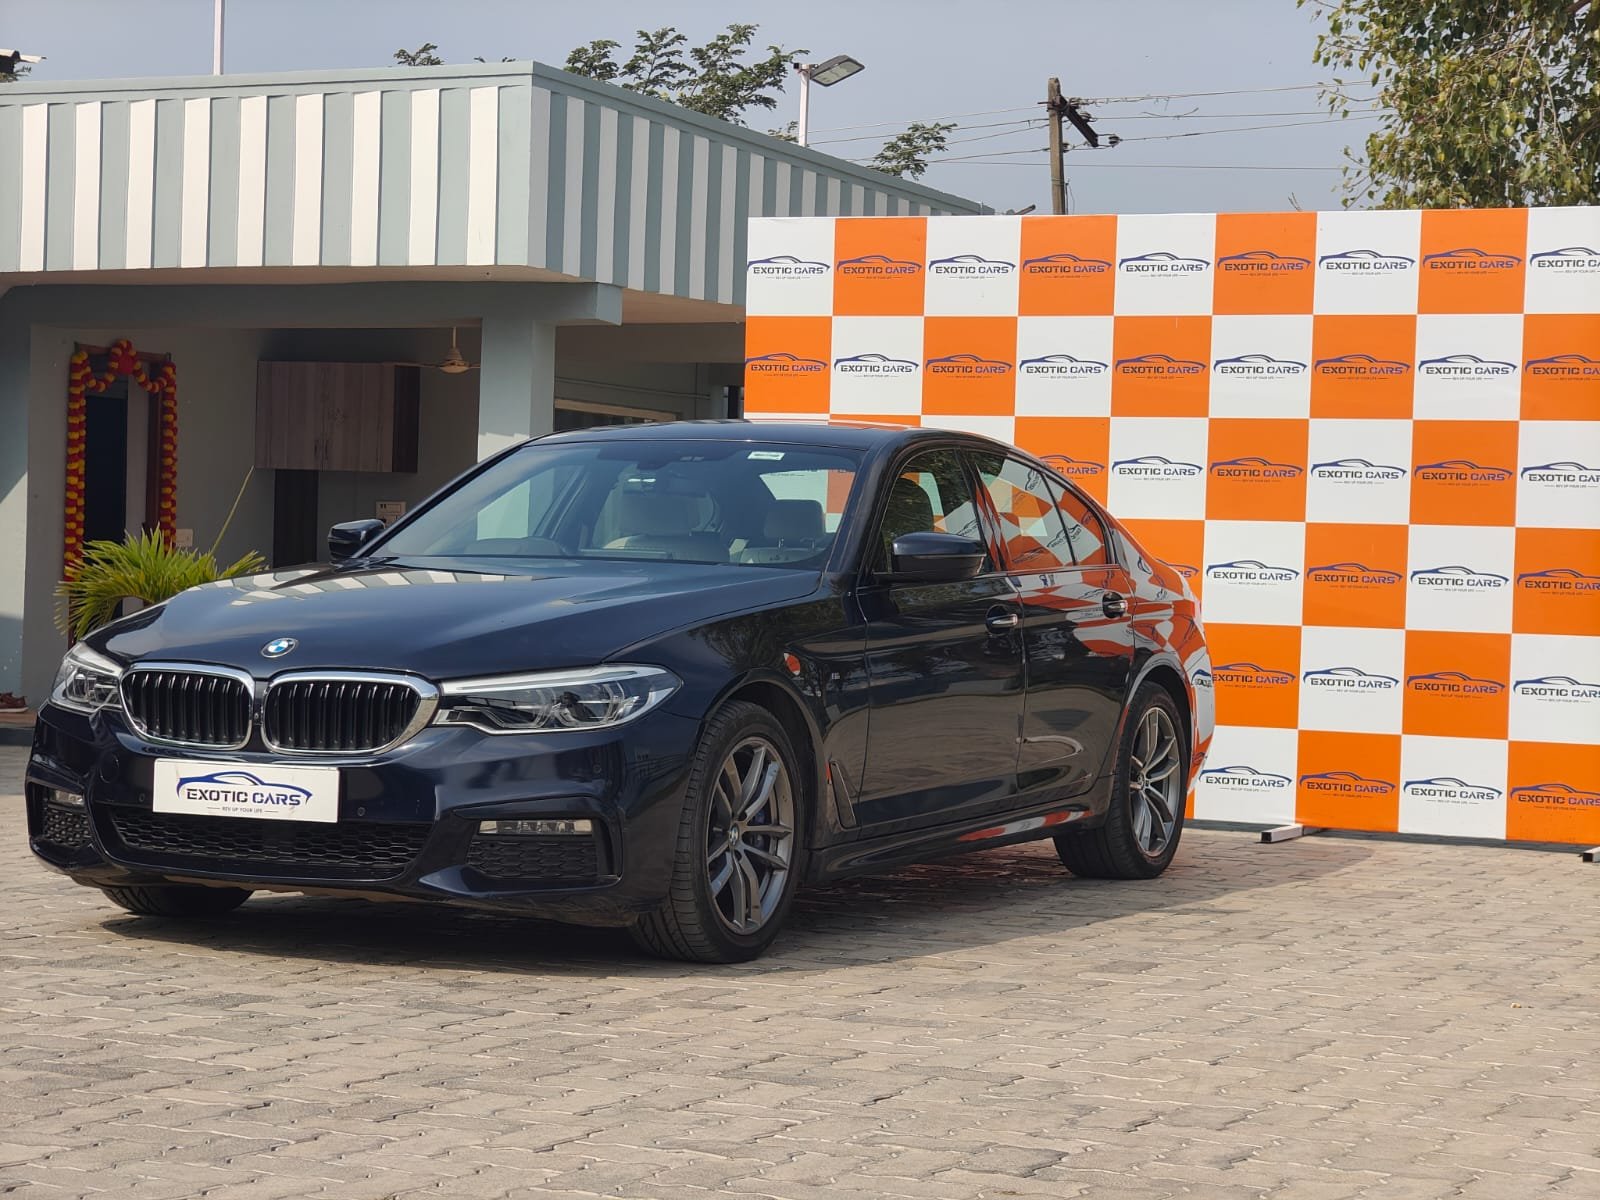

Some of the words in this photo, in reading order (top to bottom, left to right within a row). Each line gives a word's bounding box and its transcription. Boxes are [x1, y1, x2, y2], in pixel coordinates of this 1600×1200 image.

[1126, 264, 1168, 272] EXOTIC
[1224, 263, 1268, 271] EXOTIC
[1271, 262, 1304, 270] CARS
[1326, 262, 1371, 270] EXOTIC
[1373, 261, 1408, 270] CARS
[1430, 261, 1476, 269] EXOTIC
[1479, 260, 1514, 268] CARS
[1537, 259, 1585, 268] EXOTIC
[843, 266, 883, 274] EXOTIC
[885, 266, 915, 274] CARS
[935, 266, 976, 274] EXOTIC
[978, 266, 1009, 274] CARS
[1030, 265, 1071, 273] EXOTIC
[1073, 265, 1105, 273] CARS
[840, 365, 880, 373] EXOTIC
[882, 365, 913, 373] CARS
[932, 365, 973, 373] EXOTIC
[1026, 366, 1068, 374] EXOTIC
[1070, 366, 1102, 374] CARS
[1122, 366, 1164, 374] EXOTIC
[1167, 366, 1200, 374] CARS
[1220, 366, 1264, 374] EXOTIC
[1267, 366, 1300, 374] CARS
[1322, 366, 1366, 374] EXOTIC
[1425, 366, 1472, 375] EXOTIC
[1474, 367, 1510, 375] CARS
[1533, 367, 1580, 375] EXOTIC
[1066, 467, 1098, 475] CARS
[1118, 467, 1161, 475] EXOTIC
[1163, 468, 1196, 476] CARS
[1217, 469, 1260, 477] EXOTIC
[1318, 470, 1363, 479] EXOTIC
[1365, 471, 1399, 479] CARS
[1422, 472, 1467, 480] EXOTIC
[1470, 473, 1505, 481] CARS
[1528, 473, 1576, 482] EXOTIC
[1213, 571, 1257, 580] EXOTIC
[1259, 572, 1293, 581] CARS
[1314, 574, 1359, 583] EXOTIC
[1361, 576, 1395, 584] CARS
[1418, 577, 1464, 586] EXOTIC
[1466, 579, 1501, 587] CARS
[1525, 580, 1572, 589] EXOTIC
[1255, 676, 1289, 684] CARS
[1310, 677, 1355, 687] EXOTIC
[1358, 680, 1392, 689] CARS
[1414, 683, 1460, 692] EXOTIC
[1463, 685, 1498, 694] CARS
[1521, 687, 1568, 697] EXOTIC
[1206, 776, 1249, 786] EXOTIC
[1251, 779, 1285, 788] CARS
[1307, 782, 1352, 791] EXOTIC
[1354, 784, 1388, 794] CARS
[187, 788, 248, 803] EXOTIC
[252, 792, 300, 806] CARS
[1411, 787, 1457, 798] EXOTIC
[1459, 791, 1495, 800] CARS
[1518, 794, 1565, 804] EXOTIC
